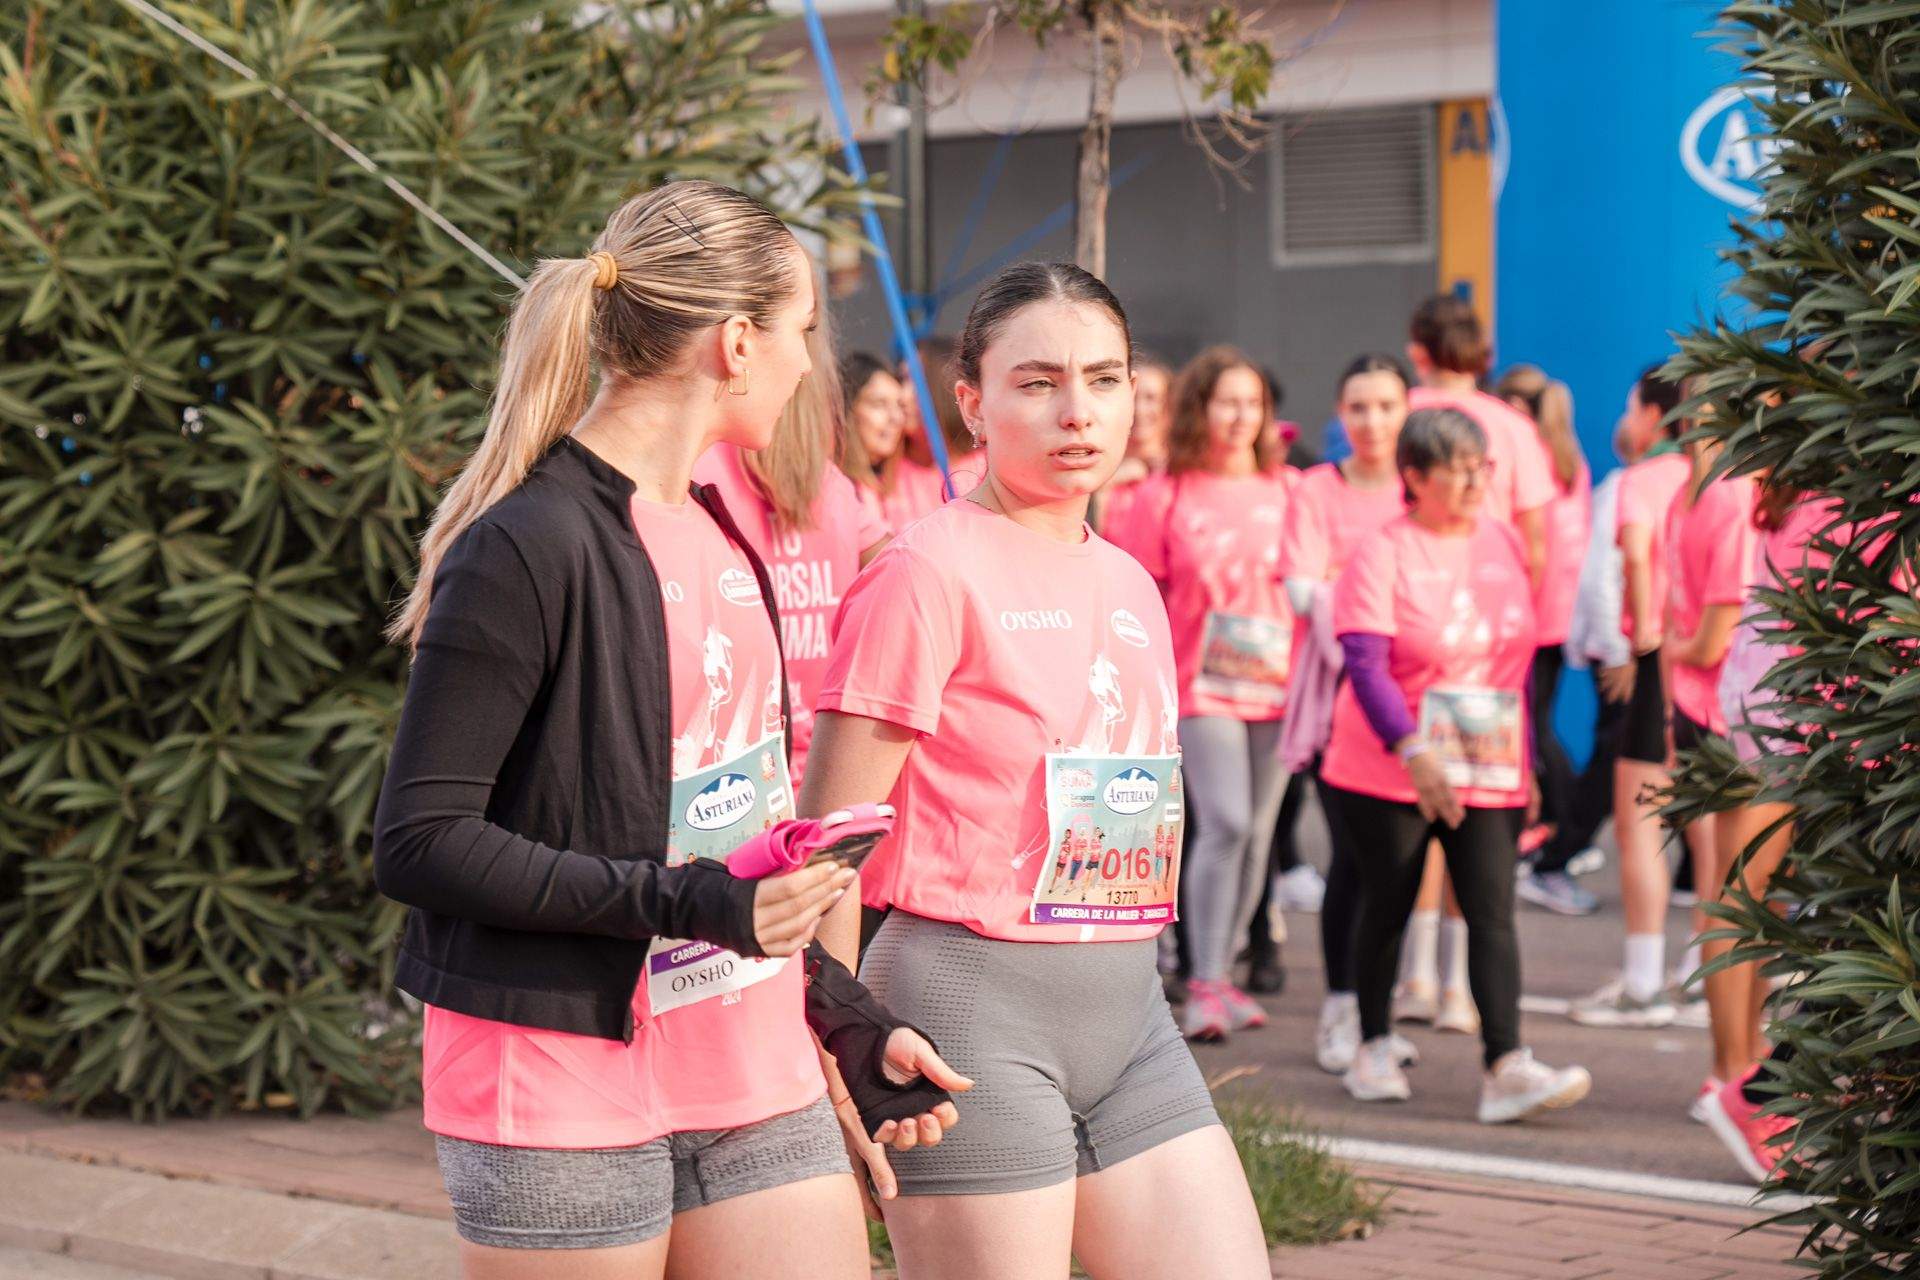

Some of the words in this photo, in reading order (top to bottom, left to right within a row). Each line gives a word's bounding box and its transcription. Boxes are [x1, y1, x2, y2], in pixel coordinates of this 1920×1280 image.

[766, 560, 840, 610] RSAL
[1000, 609, 1072, 631] OYSHO
[781, 612, 829, 661] MA
[1106, 786, 1156, 804] ASTURIANA
[1101, 847, 1151, 880] 016
[1106, 890, 1139, 905] 13770
[1051, 908, 1090, 920] CARRERA
[1091, 909, 1103, 920] DE
[1104, 909, 1116, 920] LA
[670, 942, 712, 964] CARRERA
[672, 960, 734, 992] OYSHO
